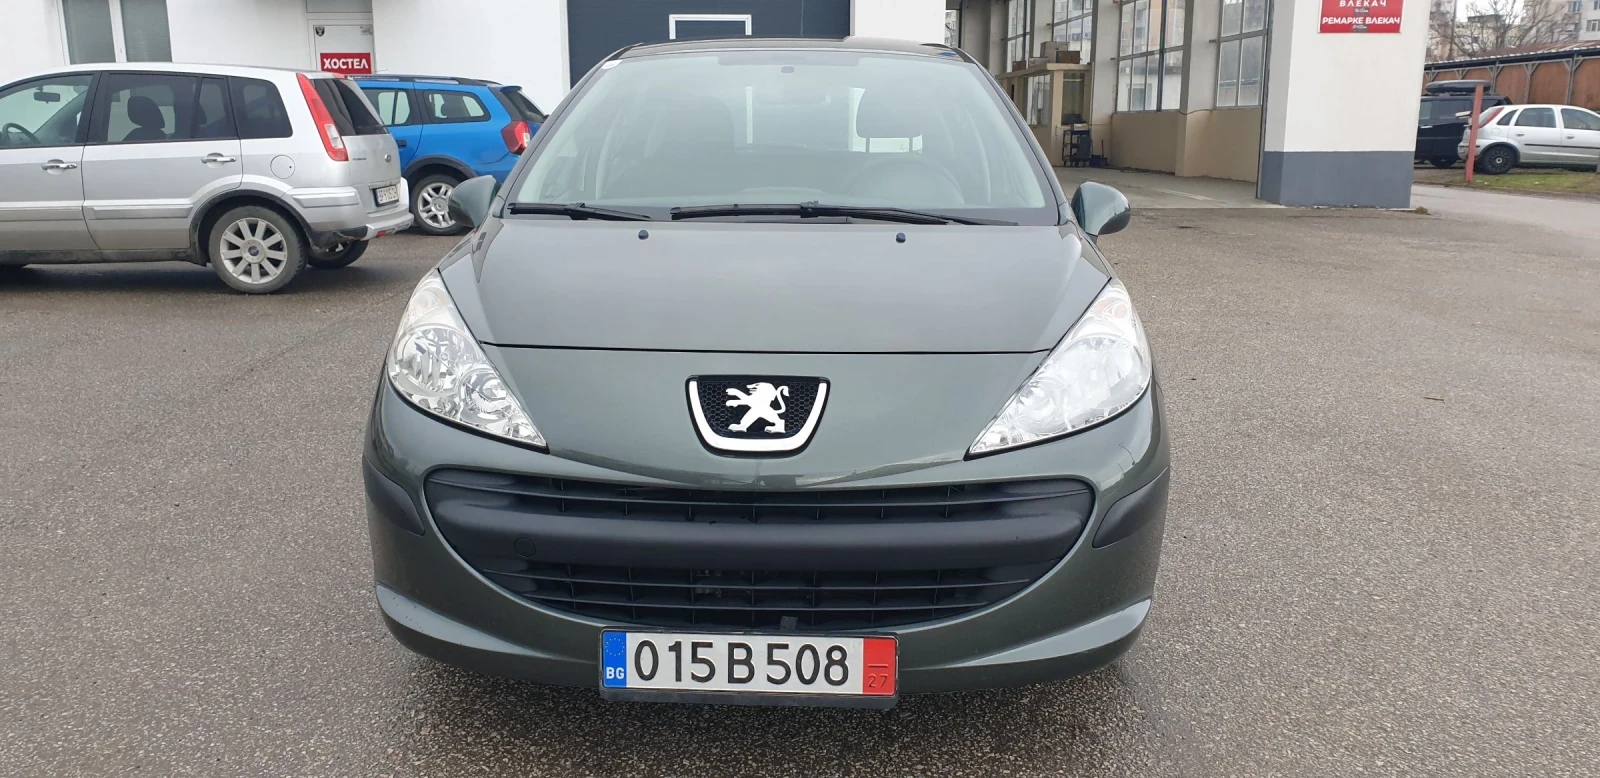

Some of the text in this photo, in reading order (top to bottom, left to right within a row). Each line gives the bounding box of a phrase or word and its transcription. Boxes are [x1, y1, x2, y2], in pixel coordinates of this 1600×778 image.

[1322, 16, 1400, 24] РЕМАРКЕ ВЛЕКАЧ
[323, 58, 369, 70] ХОСТЕЛ
[606, 666, 625, 680] BG
[867, 673, 888, 688] 27
